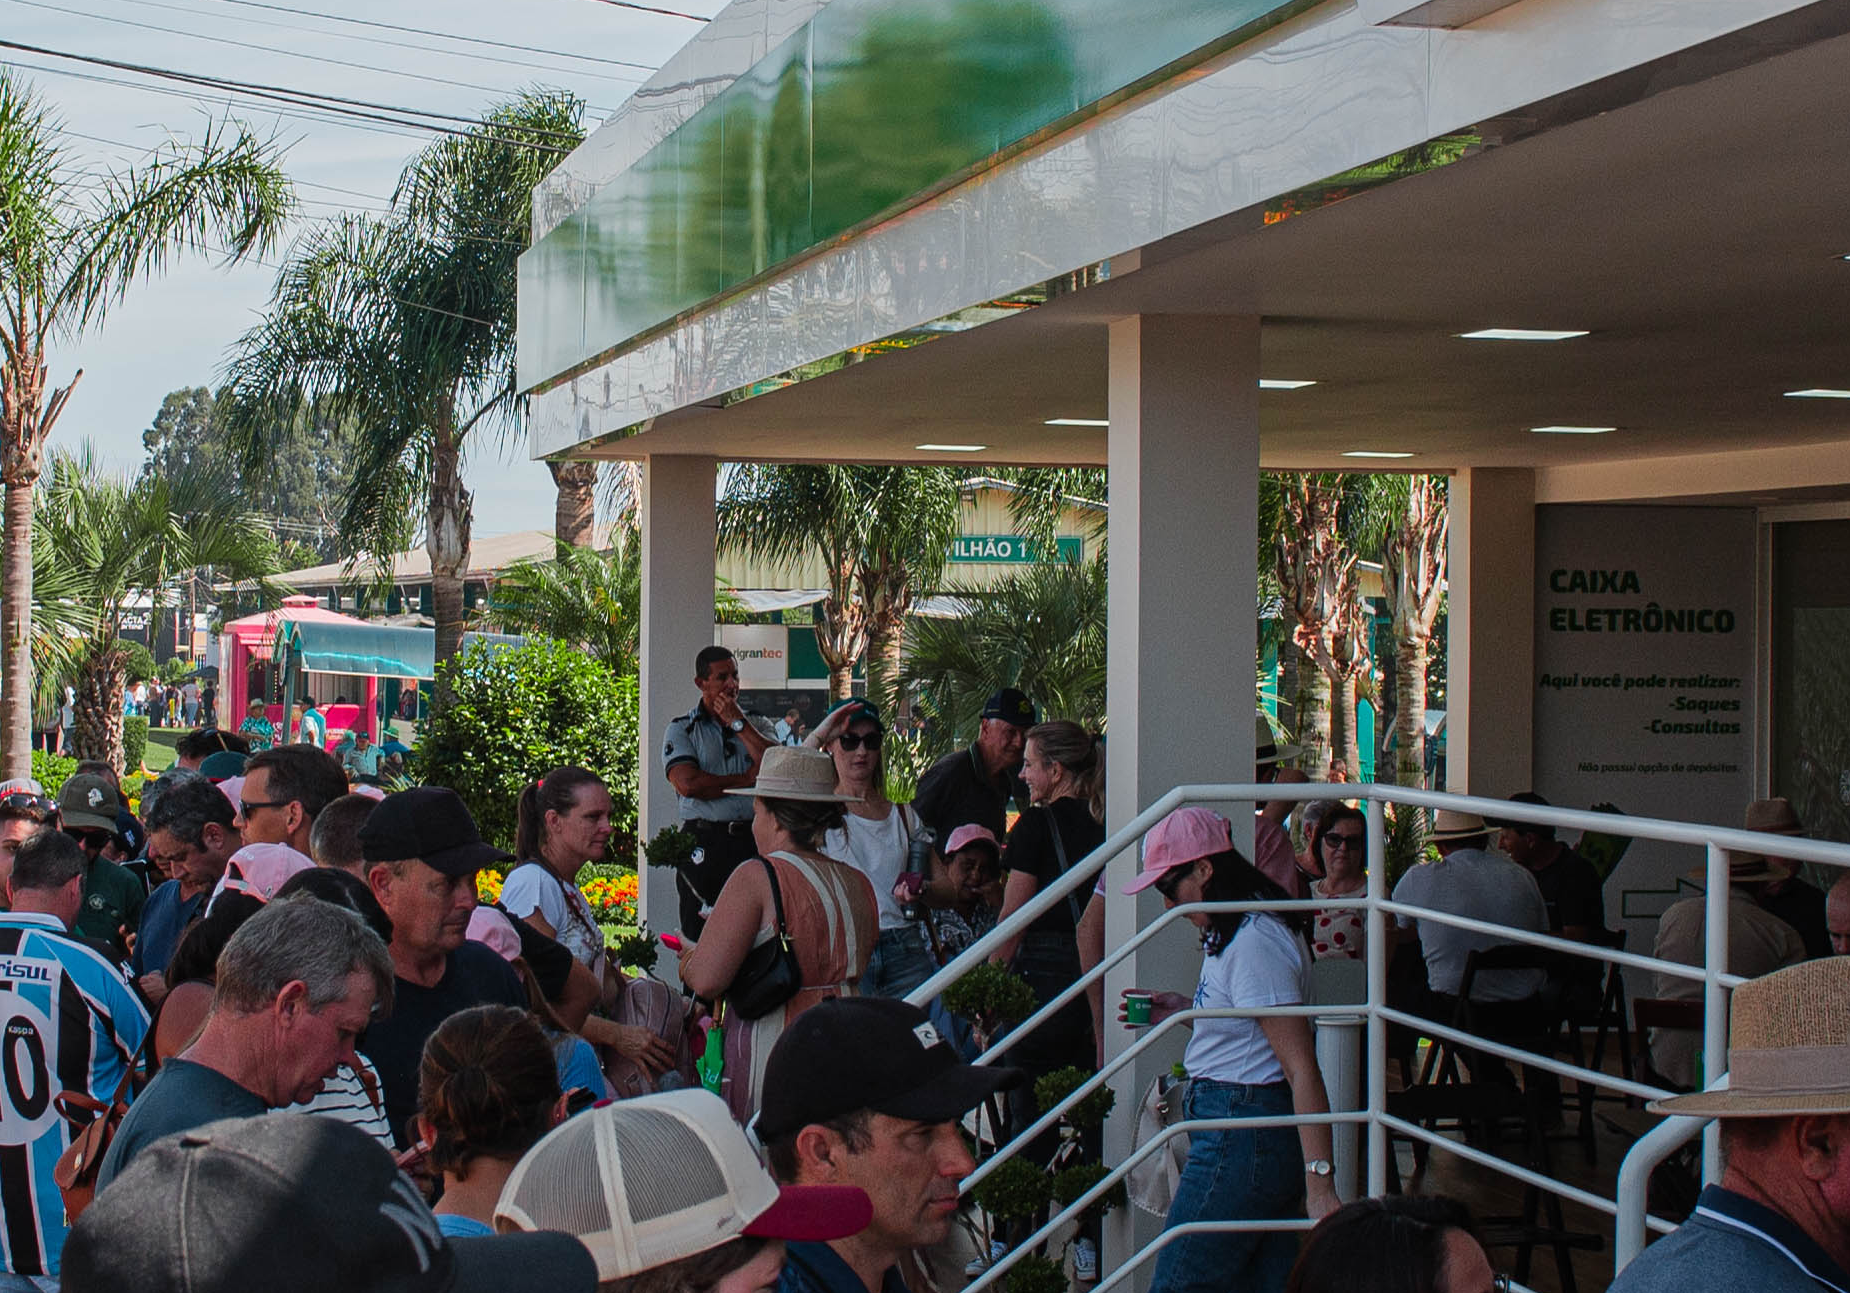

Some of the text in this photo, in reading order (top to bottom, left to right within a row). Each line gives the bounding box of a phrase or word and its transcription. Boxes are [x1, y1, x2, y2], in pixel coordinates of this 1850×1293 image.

[1549, 568, 1641, 595] CAIXA
[1549, 602, 1736, 634] ELETRÔNICO
[1540, 673, 1741, 691] Aqui você pode realizar:
[1644, 719, 1741, 735] -Consultas
[1577, 762, 1600, 773] Não
[1600, 763, 1636, 775] possui
[1637, 763, 1669, 776] opção
[1670, 763, 1685, 773] de
